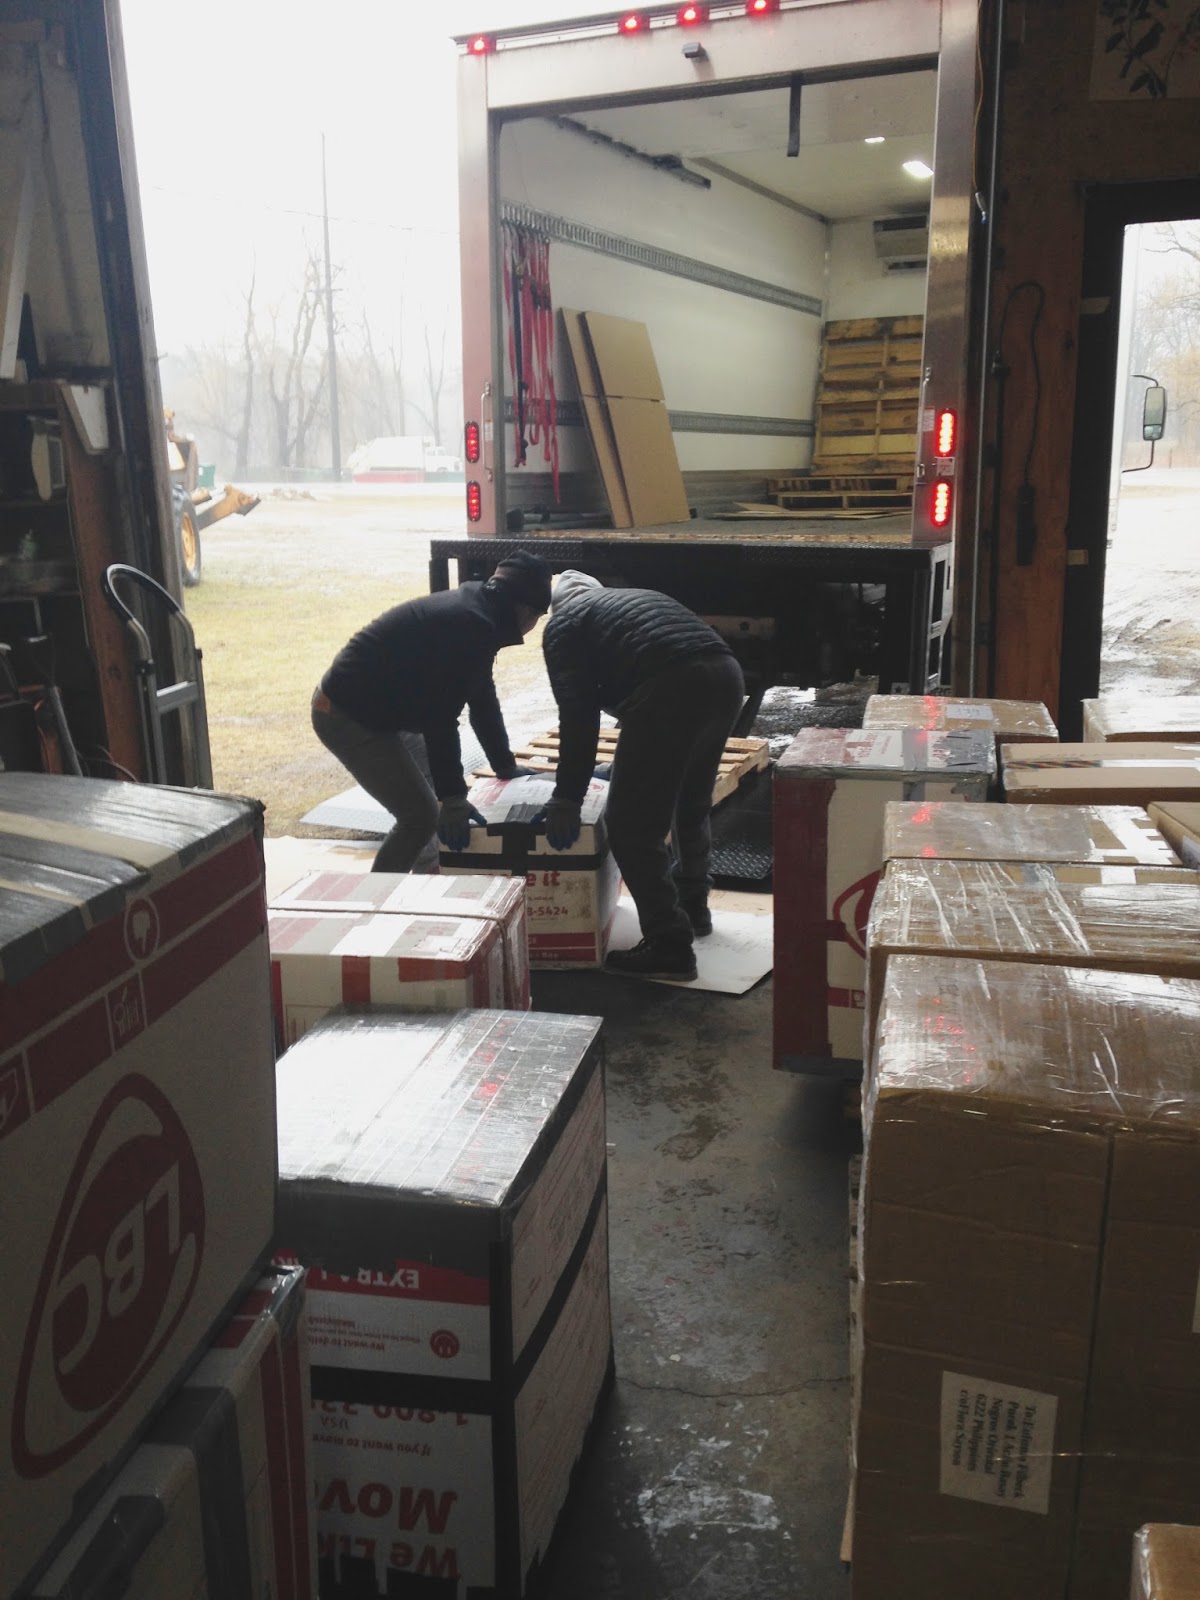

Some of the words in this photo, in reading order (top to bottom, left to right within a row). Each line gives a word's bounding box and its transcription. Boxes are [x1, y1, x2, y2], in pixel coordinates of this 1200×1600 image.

[527, 906, 569, 916] 8-5424
[51, 1160, 181, 1375] LBC
[340, 1267, 419, 1288] EXTR
[988, 1397, 1003, 1432] Negros
[347, 1438, 360, 1448] to
[362, 1439, 394, 1452] want
[397, 1443, 420, 1454] you
[314, 1479, 458, 1535] Mov
[390, 1543, 462, 1581] We
